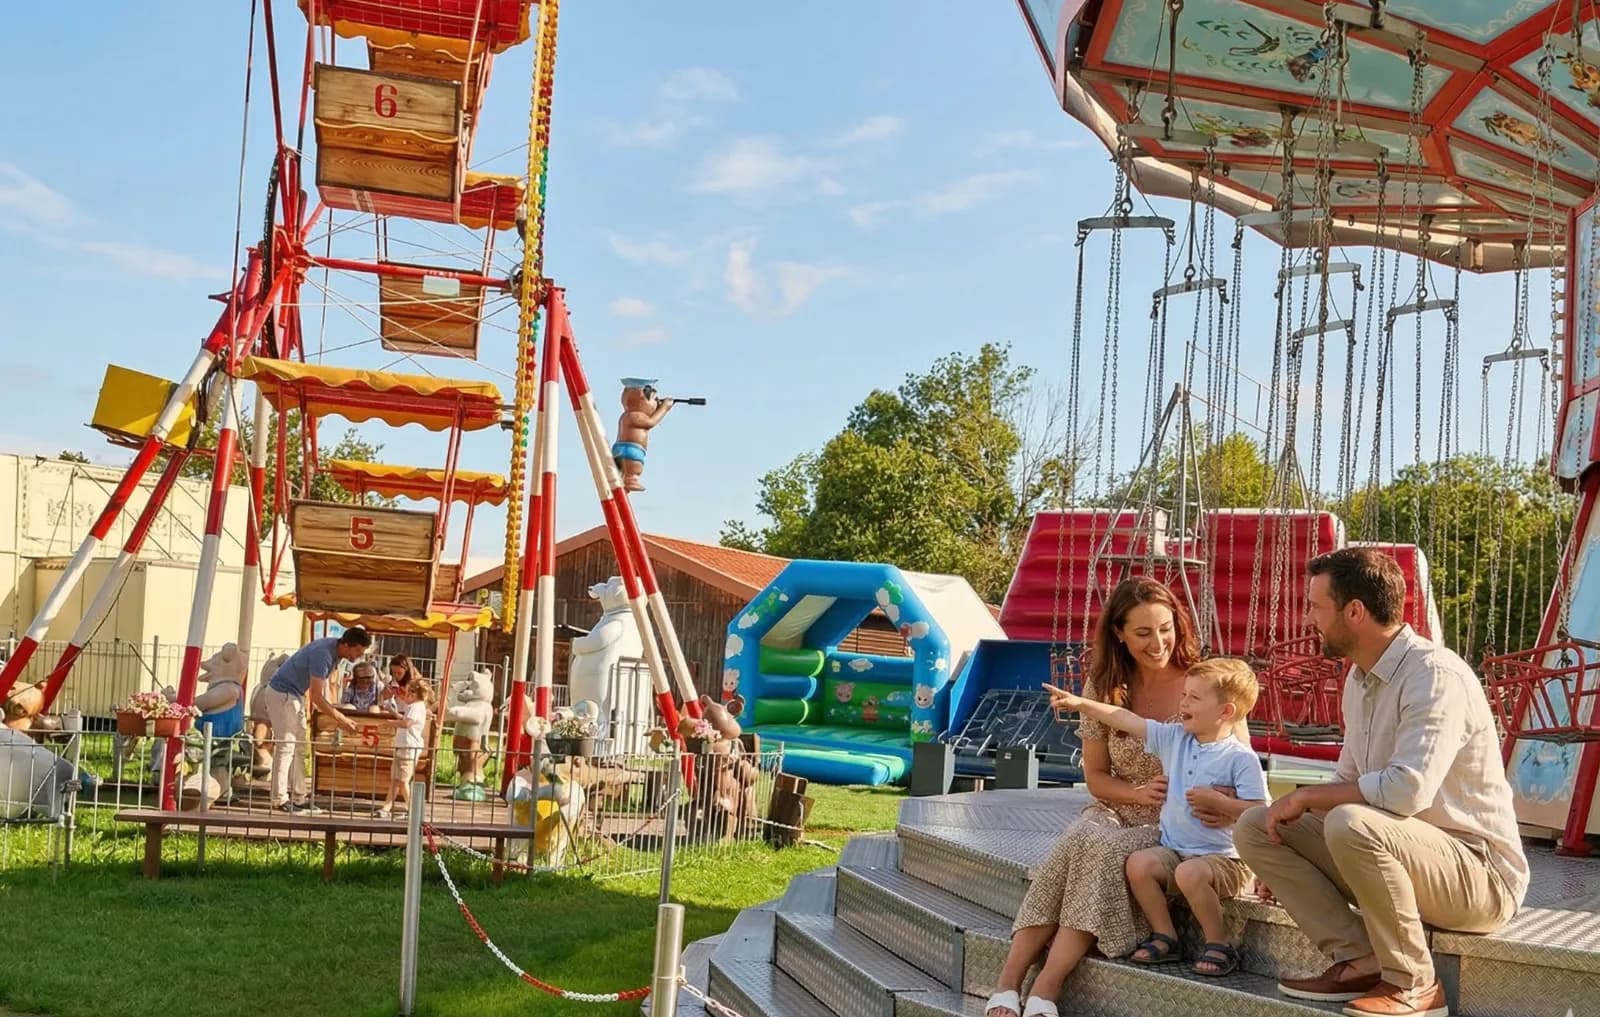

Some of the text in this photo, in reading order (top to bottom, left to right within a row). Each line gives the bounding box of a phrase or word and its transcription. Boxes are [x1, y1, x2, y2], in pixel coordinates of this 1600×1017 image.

[374, 83, 398, 118] 6
[350, 516, 374, 550] 5
[362, 724, 379, 748] 5
